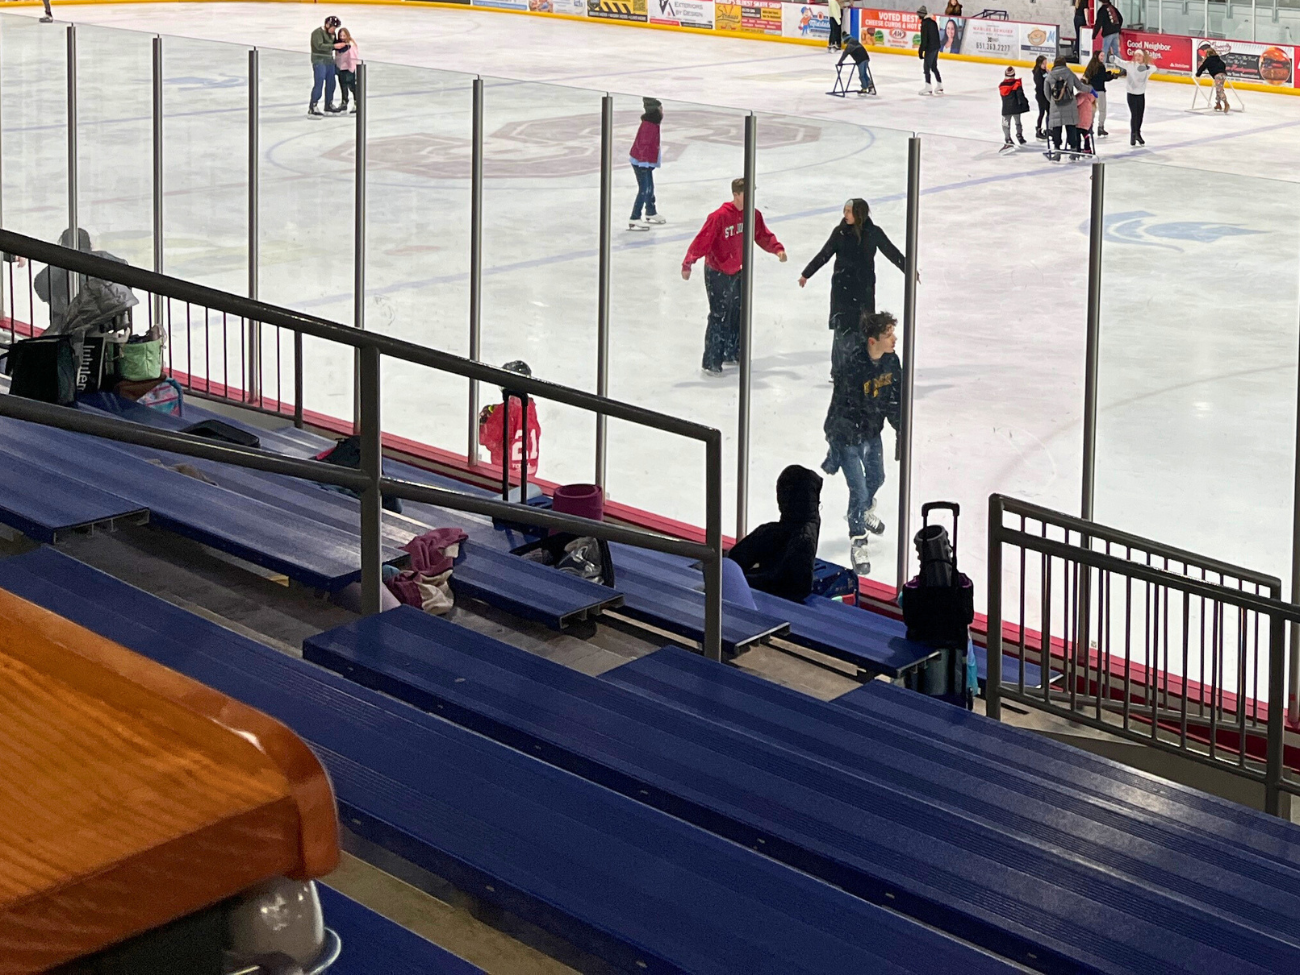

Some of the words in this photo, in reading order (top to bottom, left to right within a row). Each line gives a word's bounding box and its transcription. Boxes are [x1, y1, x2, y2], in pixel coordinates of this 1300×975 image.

[878, 12, 900, 21] VOTED
[902, 14, 919, 23] BEST
[1127, 40, 1142, 48] Good
[512, 428, 538, 460] 21
